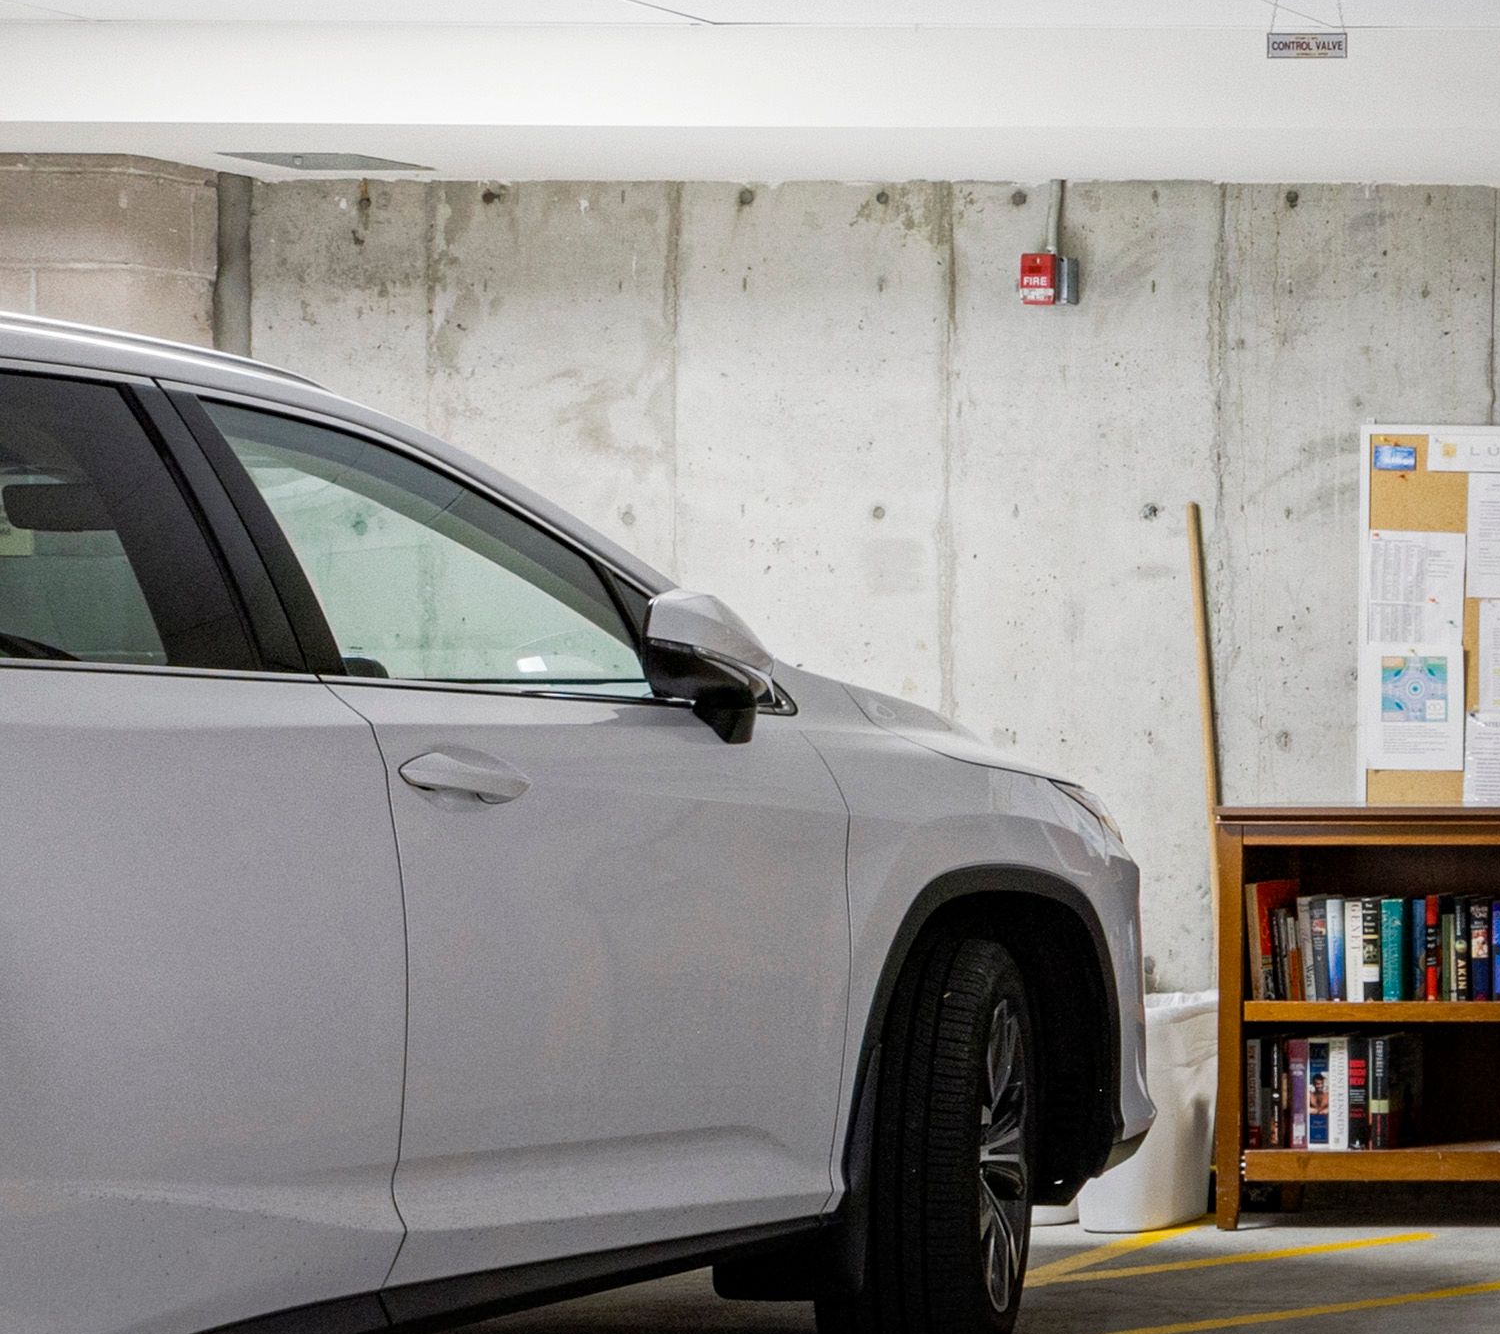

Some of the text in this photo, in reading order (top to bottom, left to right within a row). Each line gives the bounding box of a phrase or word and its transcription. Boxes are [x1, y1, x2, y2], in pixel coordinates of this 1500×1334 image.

[1271, 40, 1343, 51] CONTROL VALVE
[1023, 276, 1048, 286] FIRE
[1351, 903, 1361, 950] GENET
[1457, 959, 1467, 990] AKIN
[1336, 1092, 1345, 1136] KENNEDY
